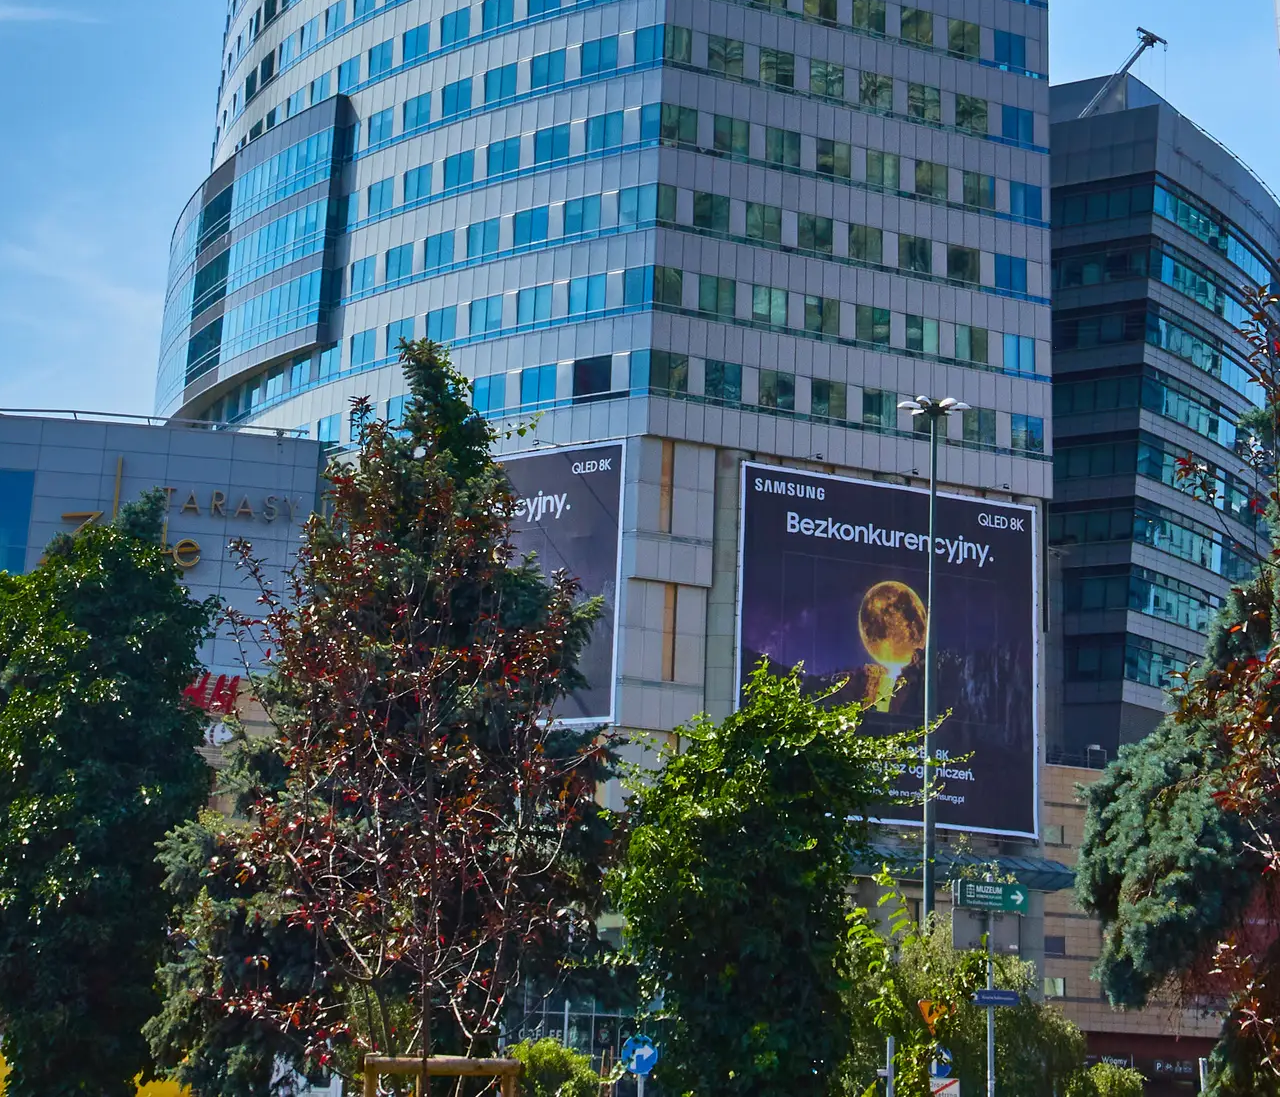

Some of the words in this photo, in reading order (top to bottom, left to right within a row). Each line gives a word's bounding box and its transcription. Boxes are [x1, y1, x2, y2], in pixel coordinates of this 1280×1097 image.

[572, 460, 598, 475] QLED
[598, 458, 612, 471] 8K
[754, 477, 826, 501] SAMSUNG
[163, 486, 303, 524] TARASY
[977, 512, 1009, 530] QLED
[1010, 518, 1025, 533] 8K
[935, 749, 950, 761] 8K
[908, 764, 976, 781] ogniczeń.
[976, 884, 1003, 896] MUZEUM
[518, 1028, 563, 1041] COFEE
